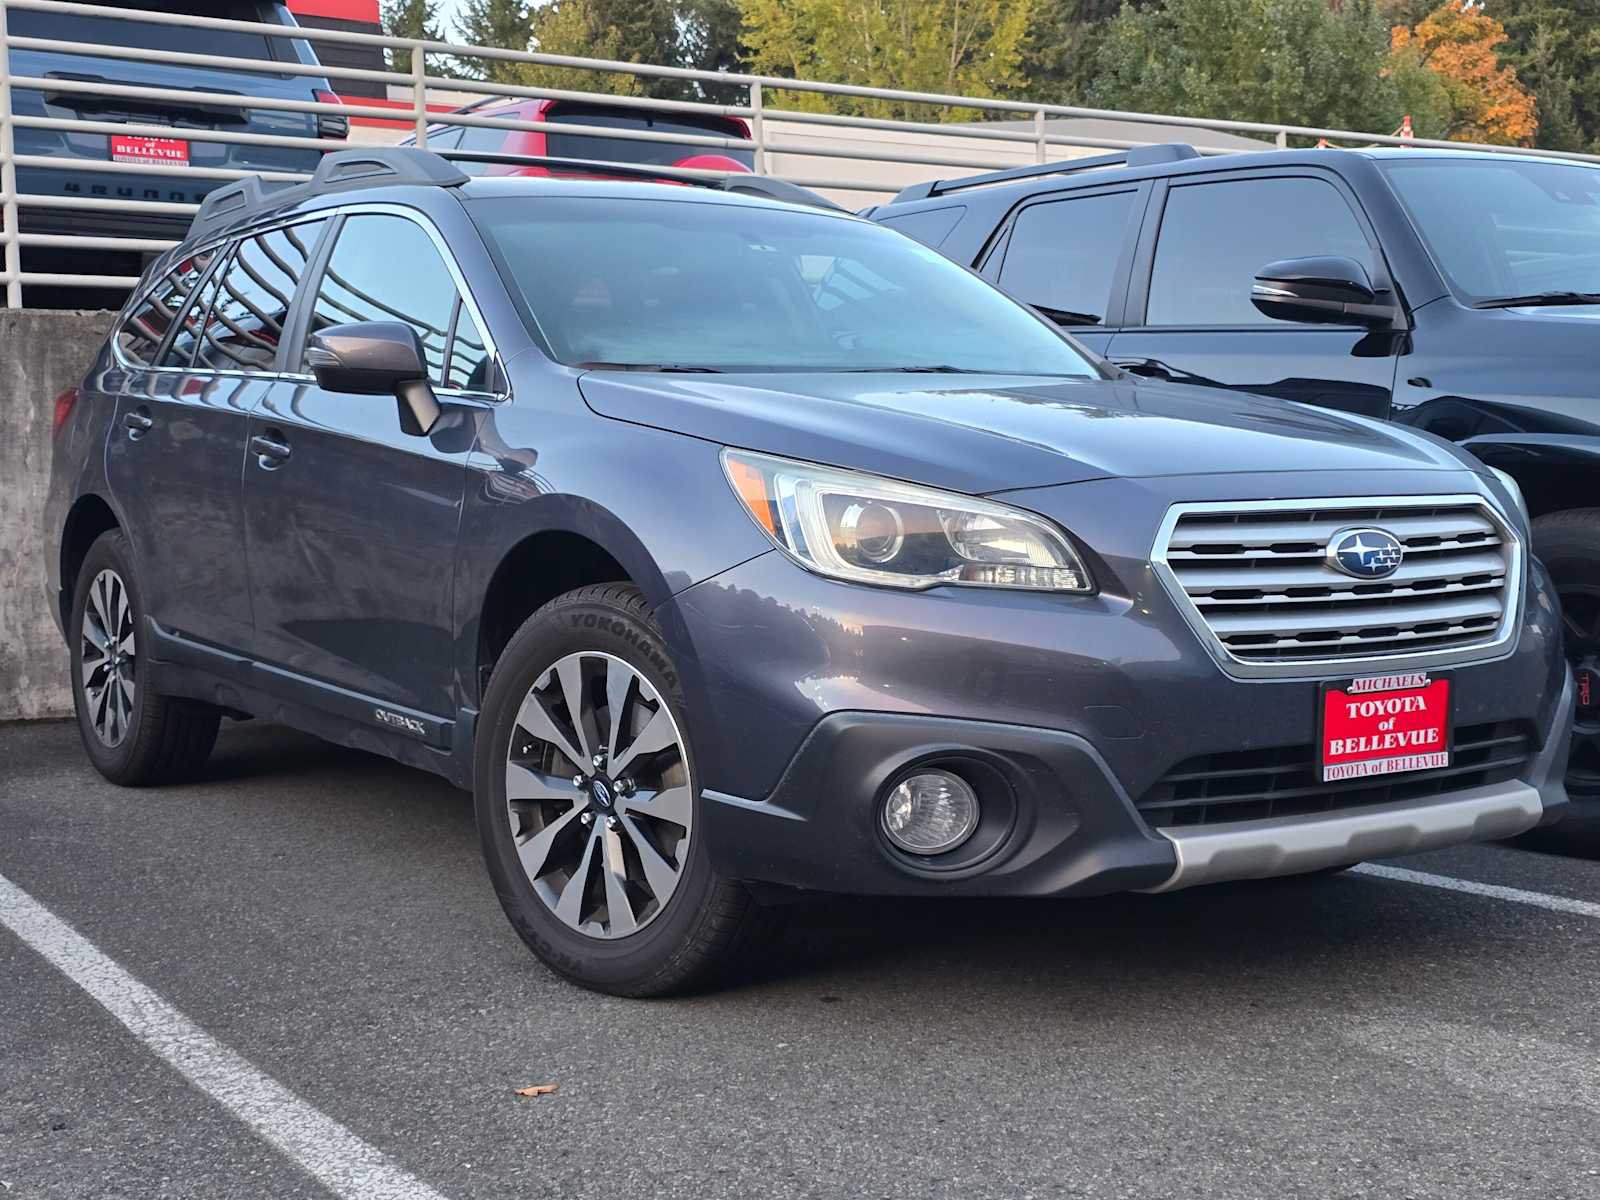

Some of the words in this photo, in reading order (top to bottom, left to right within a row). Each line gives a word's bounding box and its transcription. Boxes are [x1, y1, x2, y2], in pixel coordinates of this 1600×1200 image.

[116, 145, 185, 158] BELLEVUE
[570, 613, 678, 689] YOKOHAMA
[1353, 673, 1426, 692] MICHAELS
[1346, 695, 1427, 719] TOYOTA
[375, 708, 426, 735] OUTBACK
[1378, 716, 1396, 731] of
[1329, 728, 1439, 755] BELLEVUE
[1325, 764, 1368, 780] TOYOTA
[1371, 760, 1384, 773] of
[1386, 752, 1448, 772] BELLEVUE
